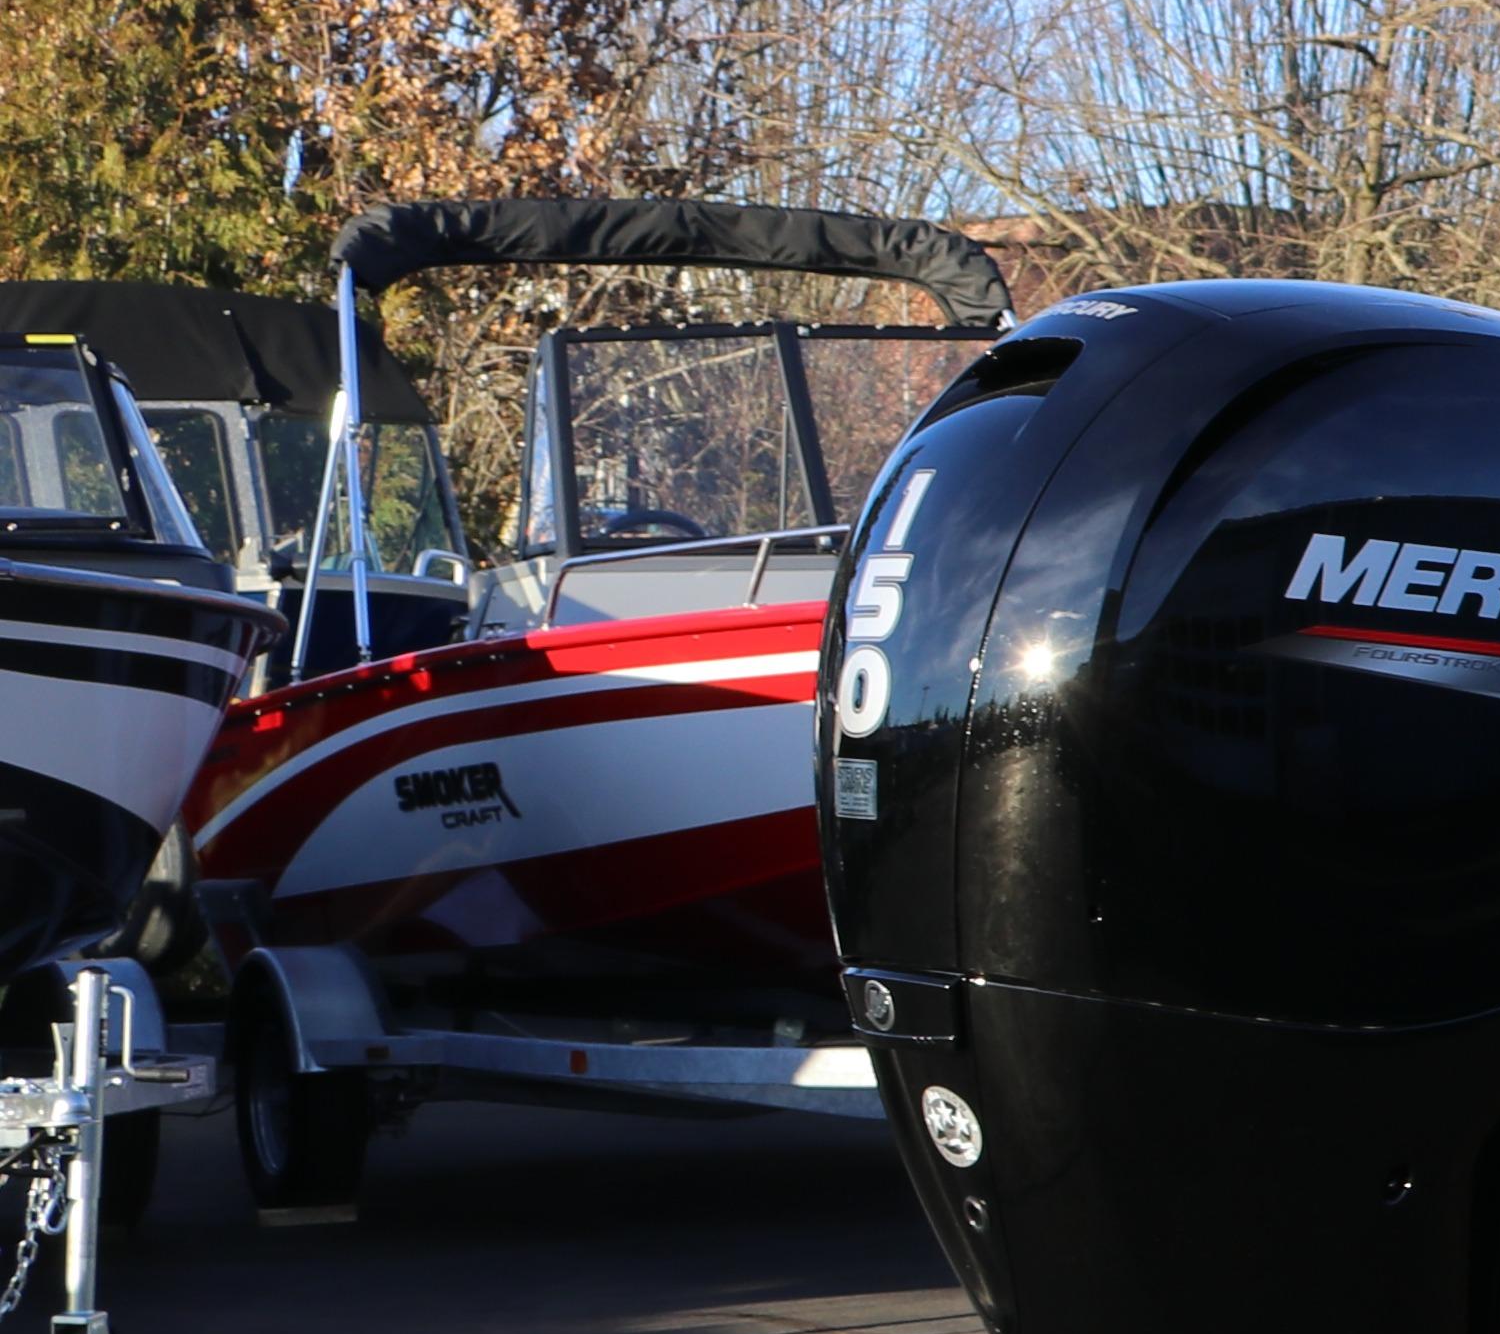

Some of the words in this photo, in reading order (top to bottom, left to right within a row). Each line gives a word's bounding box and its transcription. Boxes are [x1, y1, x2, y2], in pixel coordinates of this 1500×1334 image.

[838, 468, 937, 739] 150
[394, 762, 521, 818] SMOKER
[441, 805, 503, 830] CRAFT
